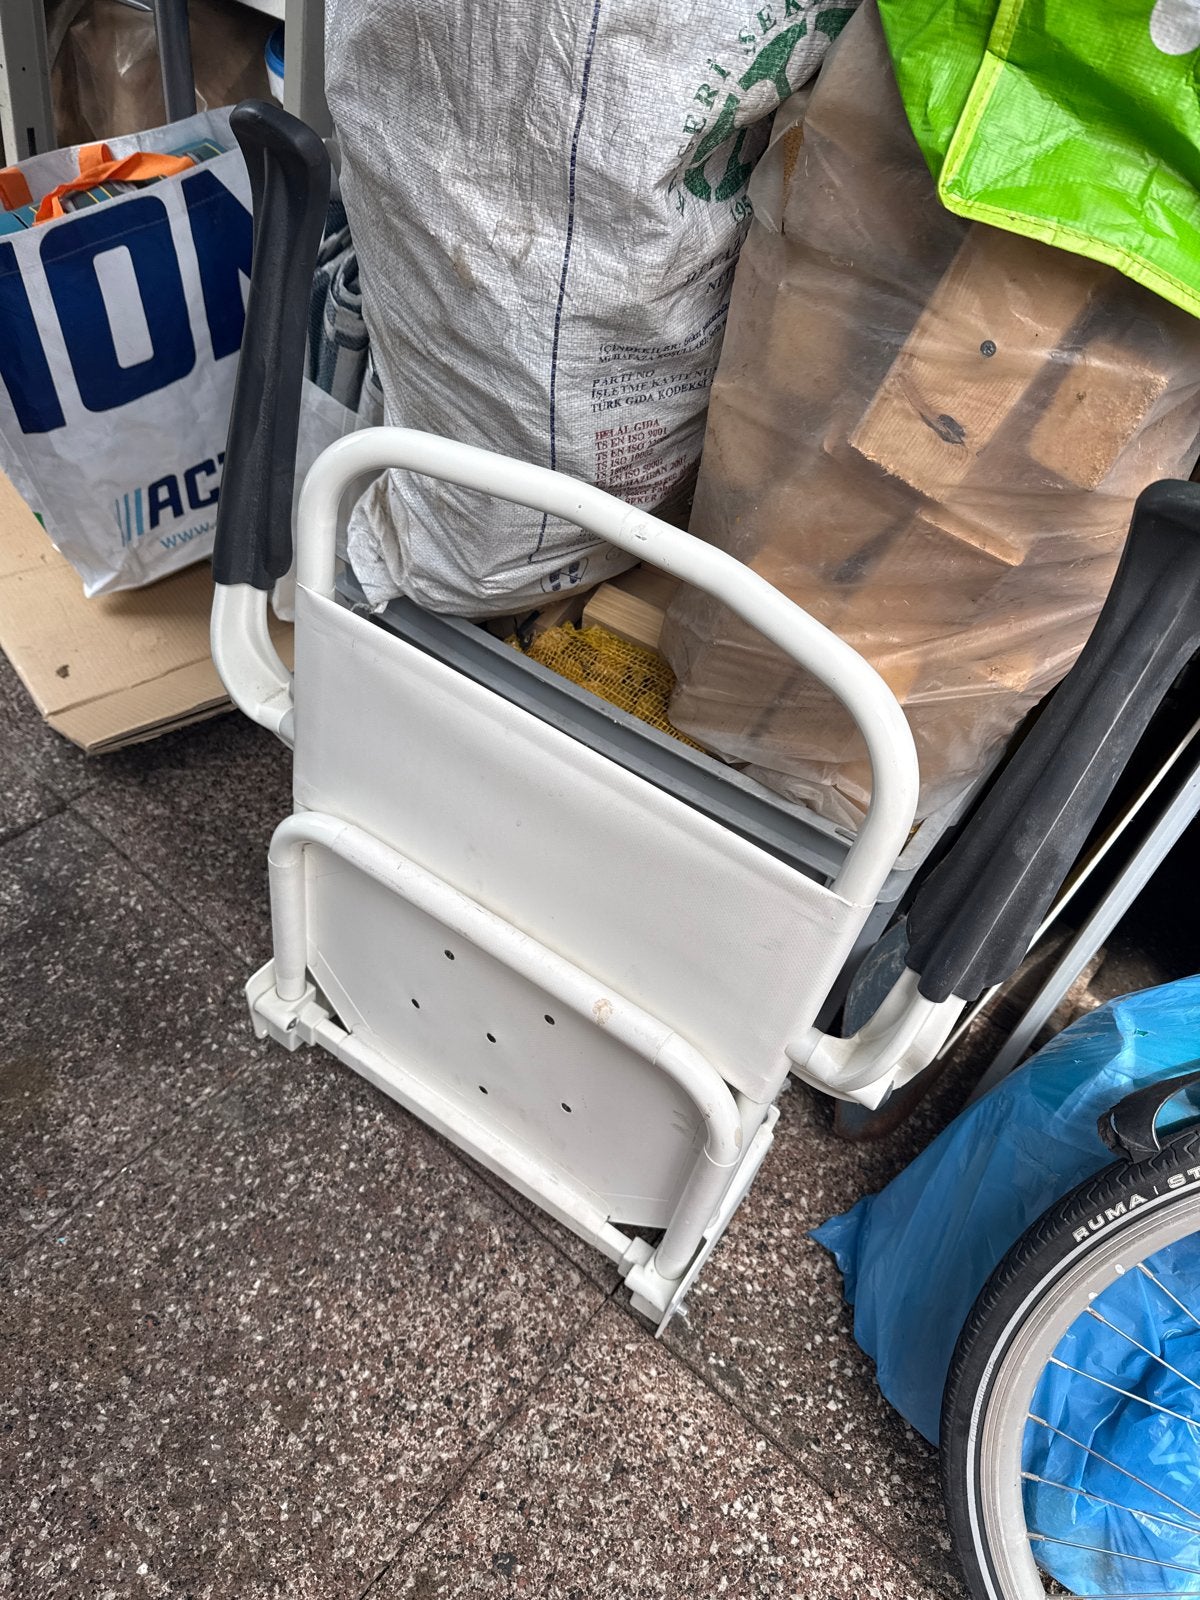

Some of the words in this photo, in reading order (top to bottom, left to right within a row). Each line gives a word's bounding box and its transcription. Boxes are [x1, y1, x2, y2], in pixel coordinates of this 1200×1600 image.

[635, 369, 655, 379] NO
[591, 398, 622, 414] TÜRK
[595, 440, 607, 451] TS
[610, 436, 625, 448] EN
[628, 431, 645, 444] ISO
[595, 451, 608, 461] TS
[610, 447, 625, 458] EN
[628, 442, 645, 454] ISO
[595, 461, 608, 471] TS
[611, 456, 627, 468] ISO
[148, 451, 225, 530] AC
[159, 521, 217, 549] www.
[1072, 1194, 1148, 1242] RUMA
